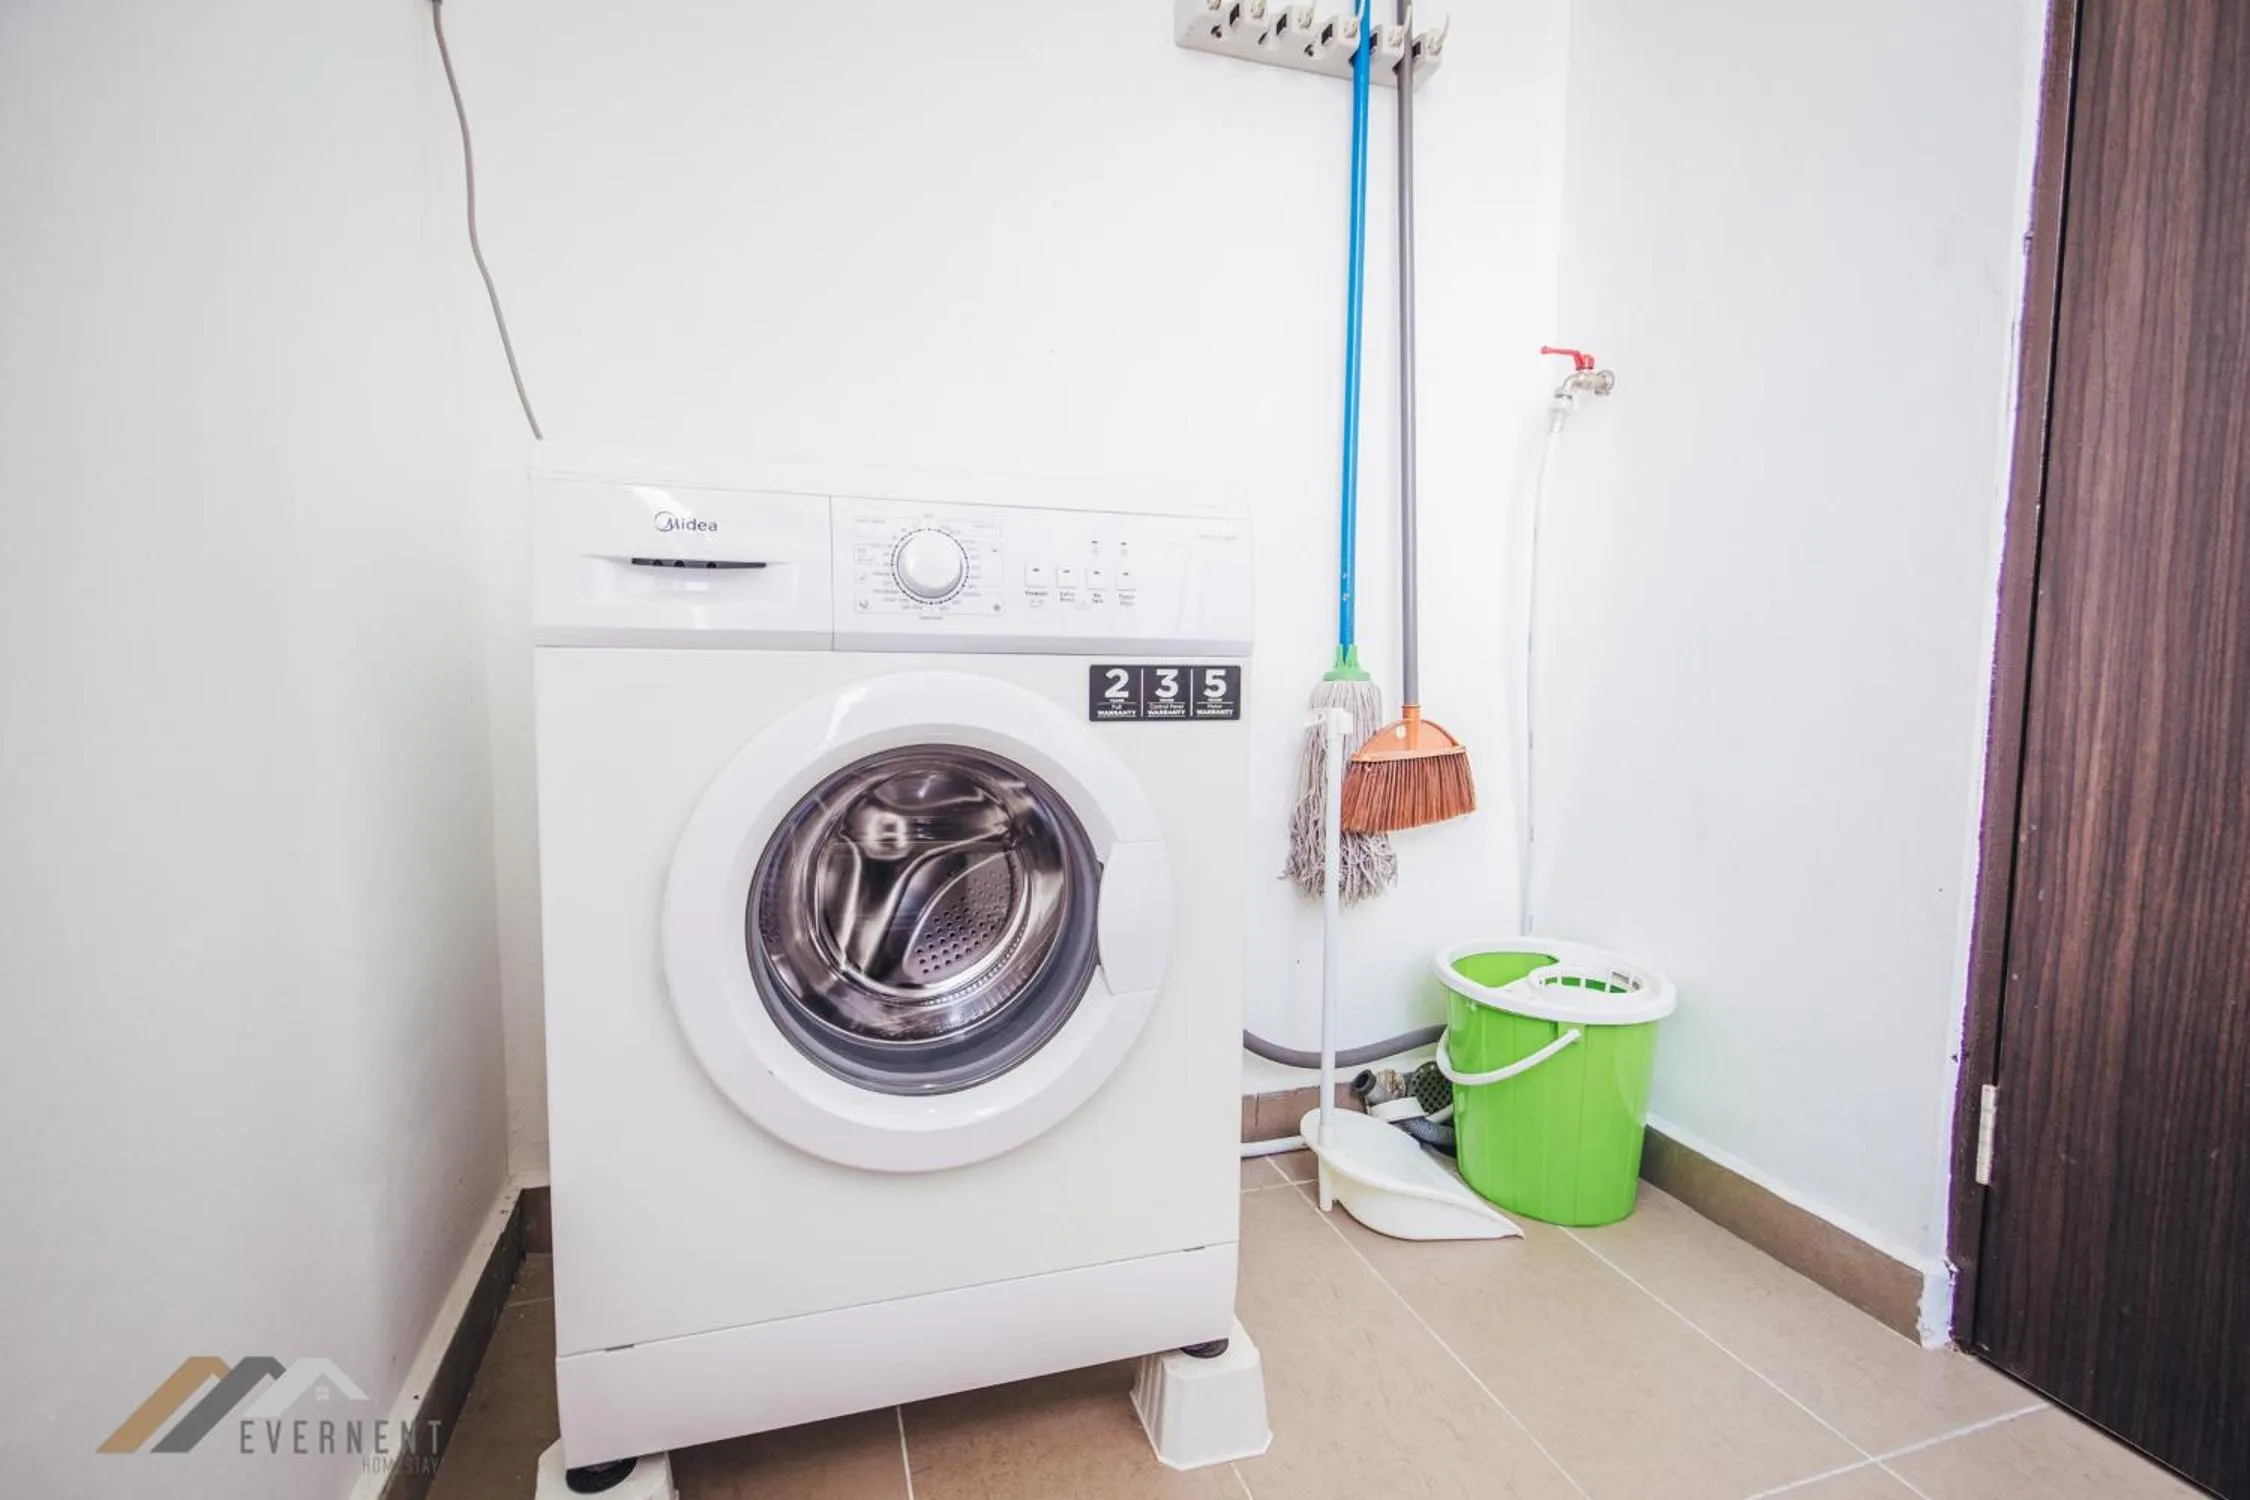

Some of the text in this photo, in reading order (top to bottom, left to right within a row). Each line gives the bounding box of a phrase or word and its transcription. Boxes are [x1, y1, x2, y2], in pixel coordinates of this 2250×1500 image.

[654, 511, 718, 532] Midea
[1104, 668, 1129, 698] 2
[1155, 668, 1179, 698] 3
[1203, 668, 1227, 698] 5
